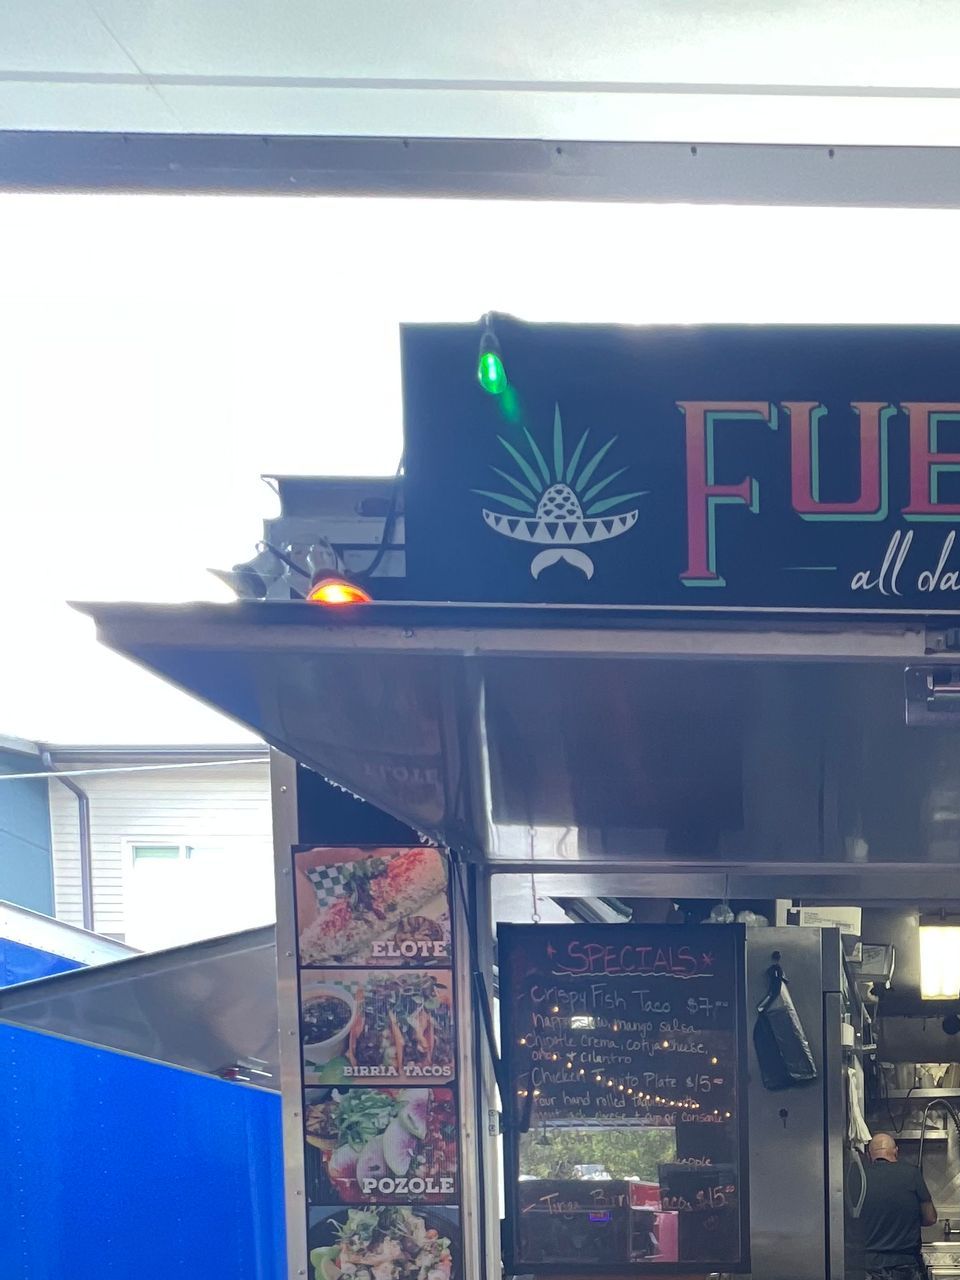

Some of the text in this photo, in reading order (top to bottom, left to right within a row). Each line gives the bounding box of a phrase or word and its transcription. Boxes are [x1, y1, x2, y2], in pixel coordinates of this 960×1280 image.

[851, 530, 914, 596] all
[371, 941, 447, 958] ELOTE
[557, 941, 699, 975] SPECIALS
[591, 983, 626, 1010] Fish
[632, 989, 671, 1013] Taco
[343, 1065, 451, 1077] BIRRIA TACOS
[362, 1177, 454, 1194] POZOLE
